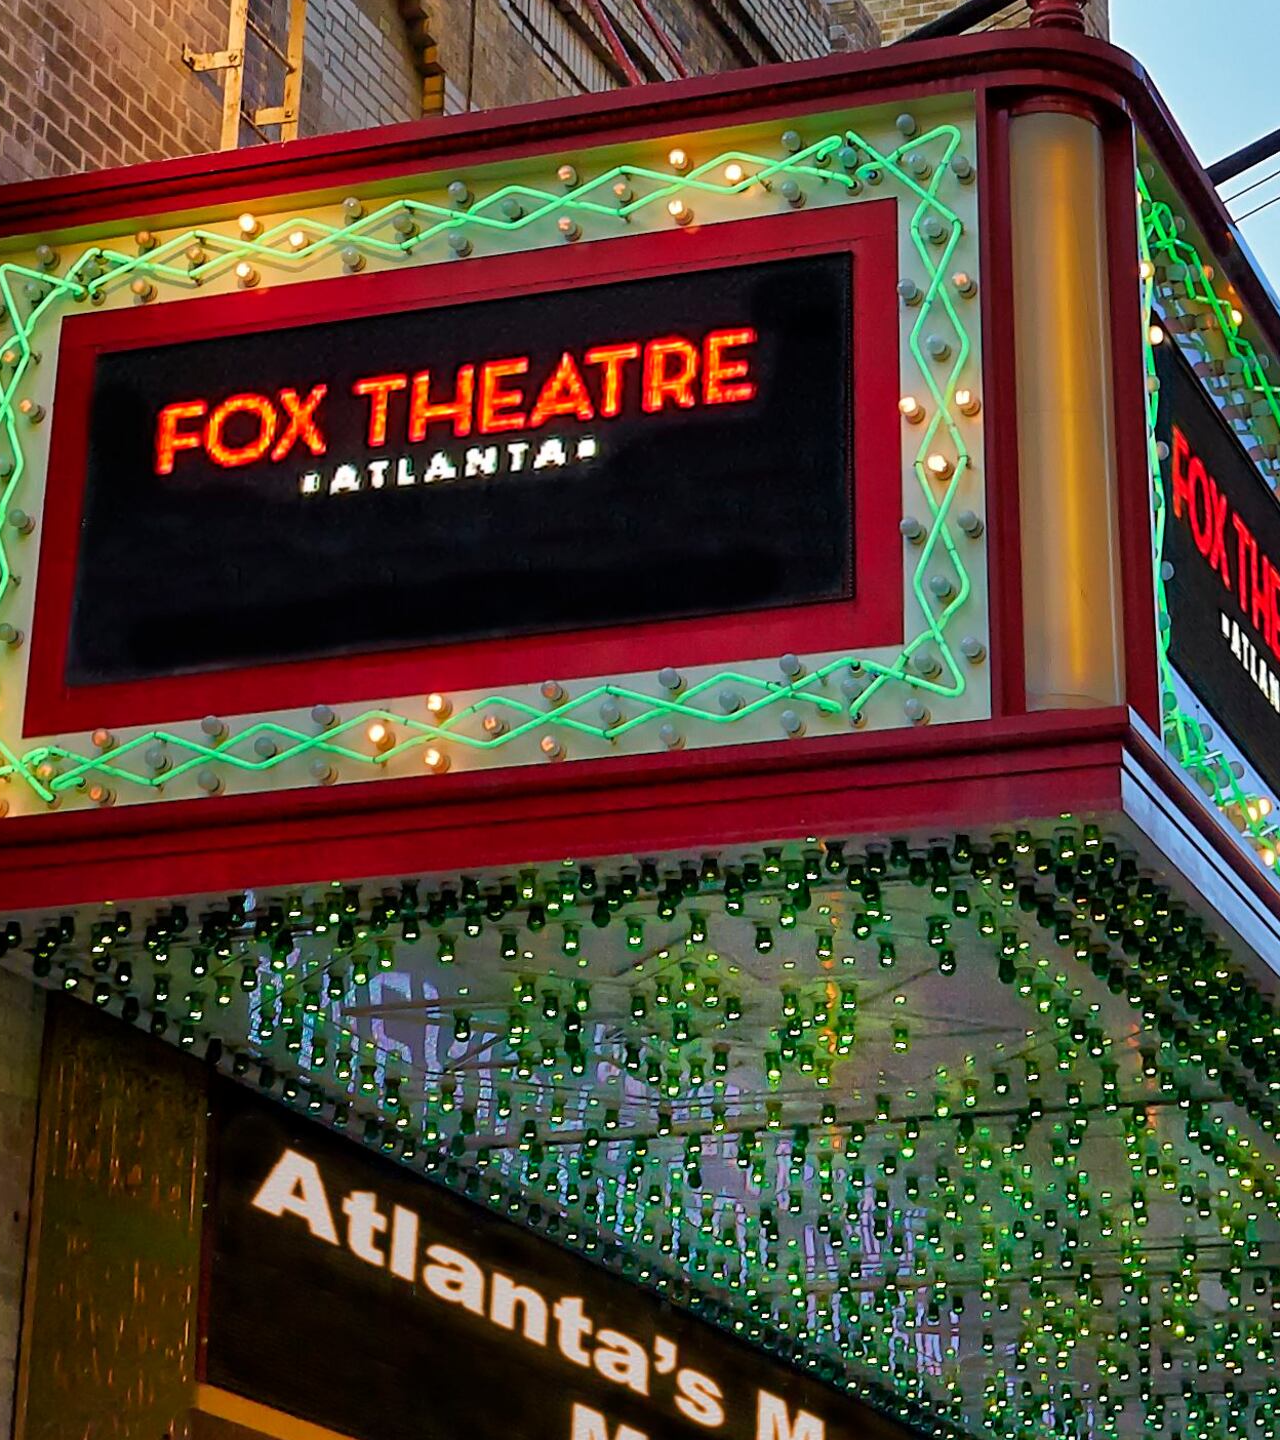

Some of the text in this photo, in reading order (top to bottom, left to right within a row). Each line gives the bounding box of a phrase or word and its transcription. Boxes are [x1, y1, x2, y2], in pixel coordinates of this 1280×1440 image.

[155, 327, 759, 475] FOX THEATRE
[328, 437, 570, 496] ATLANTA
[1171, 424, 1232, 592] FOX
[252, 1149, 726, 1428] Atlanta's
